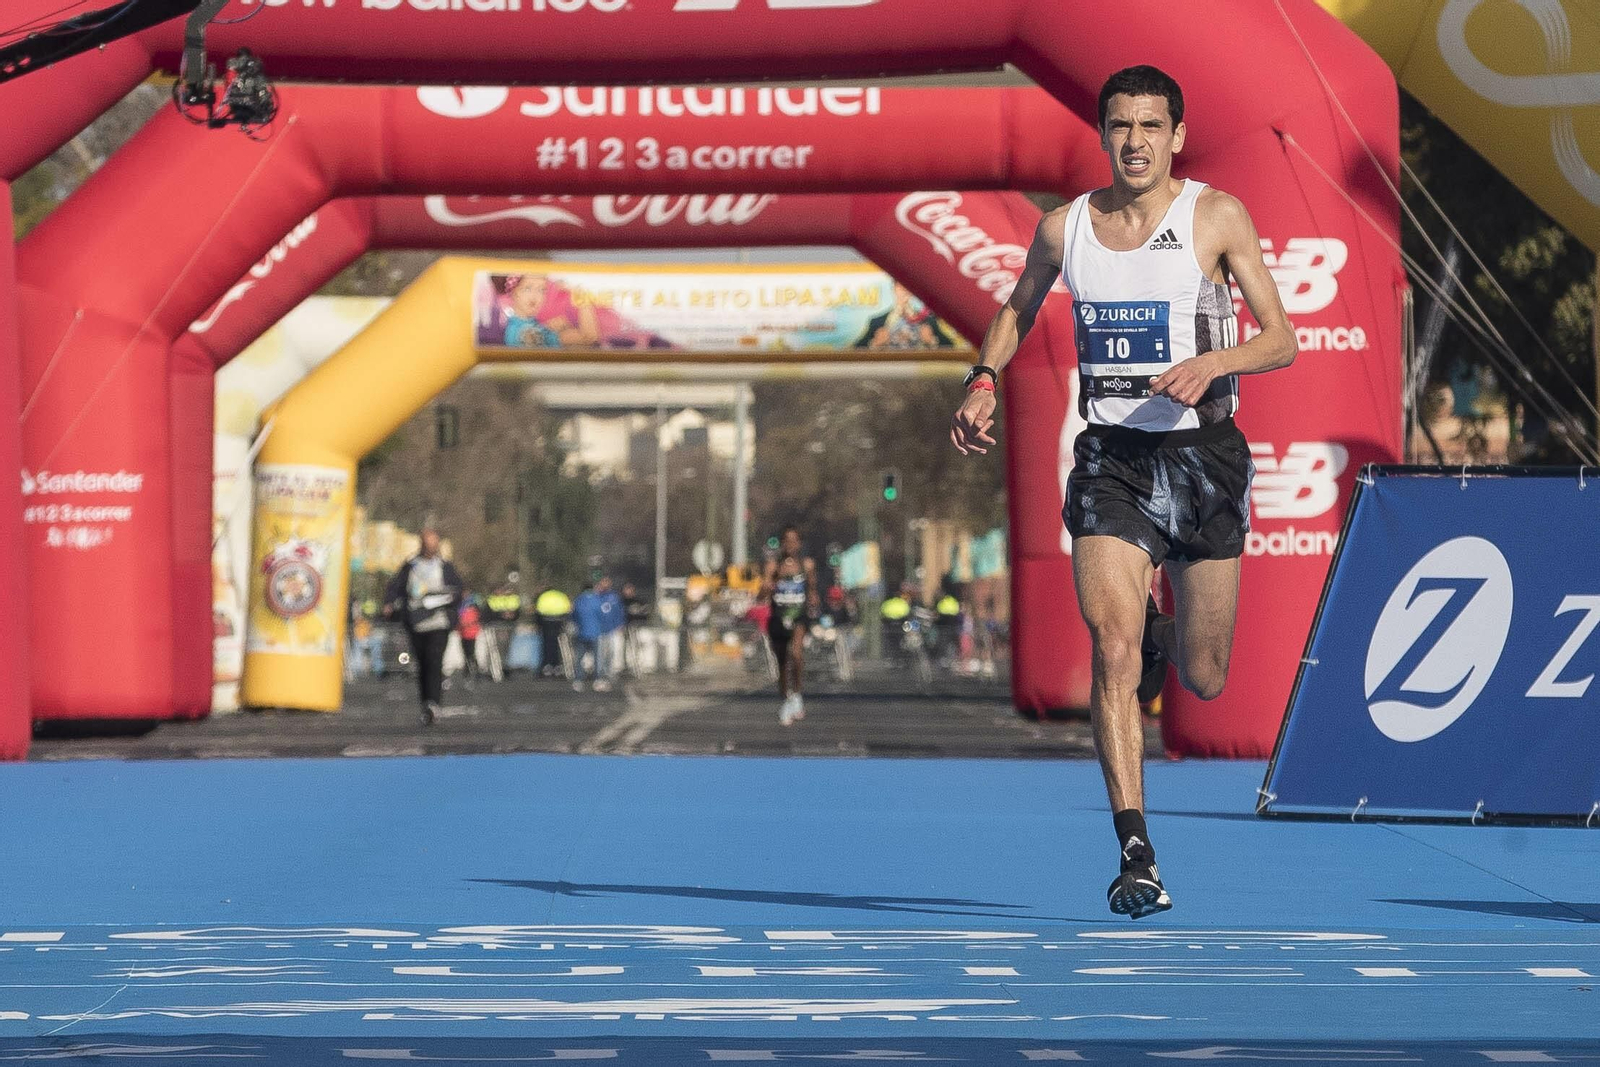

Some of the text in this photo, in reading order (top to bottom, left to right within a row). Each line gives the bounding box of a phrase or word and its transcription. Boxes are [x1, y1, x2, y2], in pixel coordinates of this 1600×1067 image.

[1149, 242, 1183, 250] adidas
[1099, 308, 1156, 320] ZURICH
[1106, 337, 1130, 358] 10
[37, 470, 144, 494] Santander
[1244, 525, 1340, 555] balan
[92, 965, 1595, 977] ZURICH
